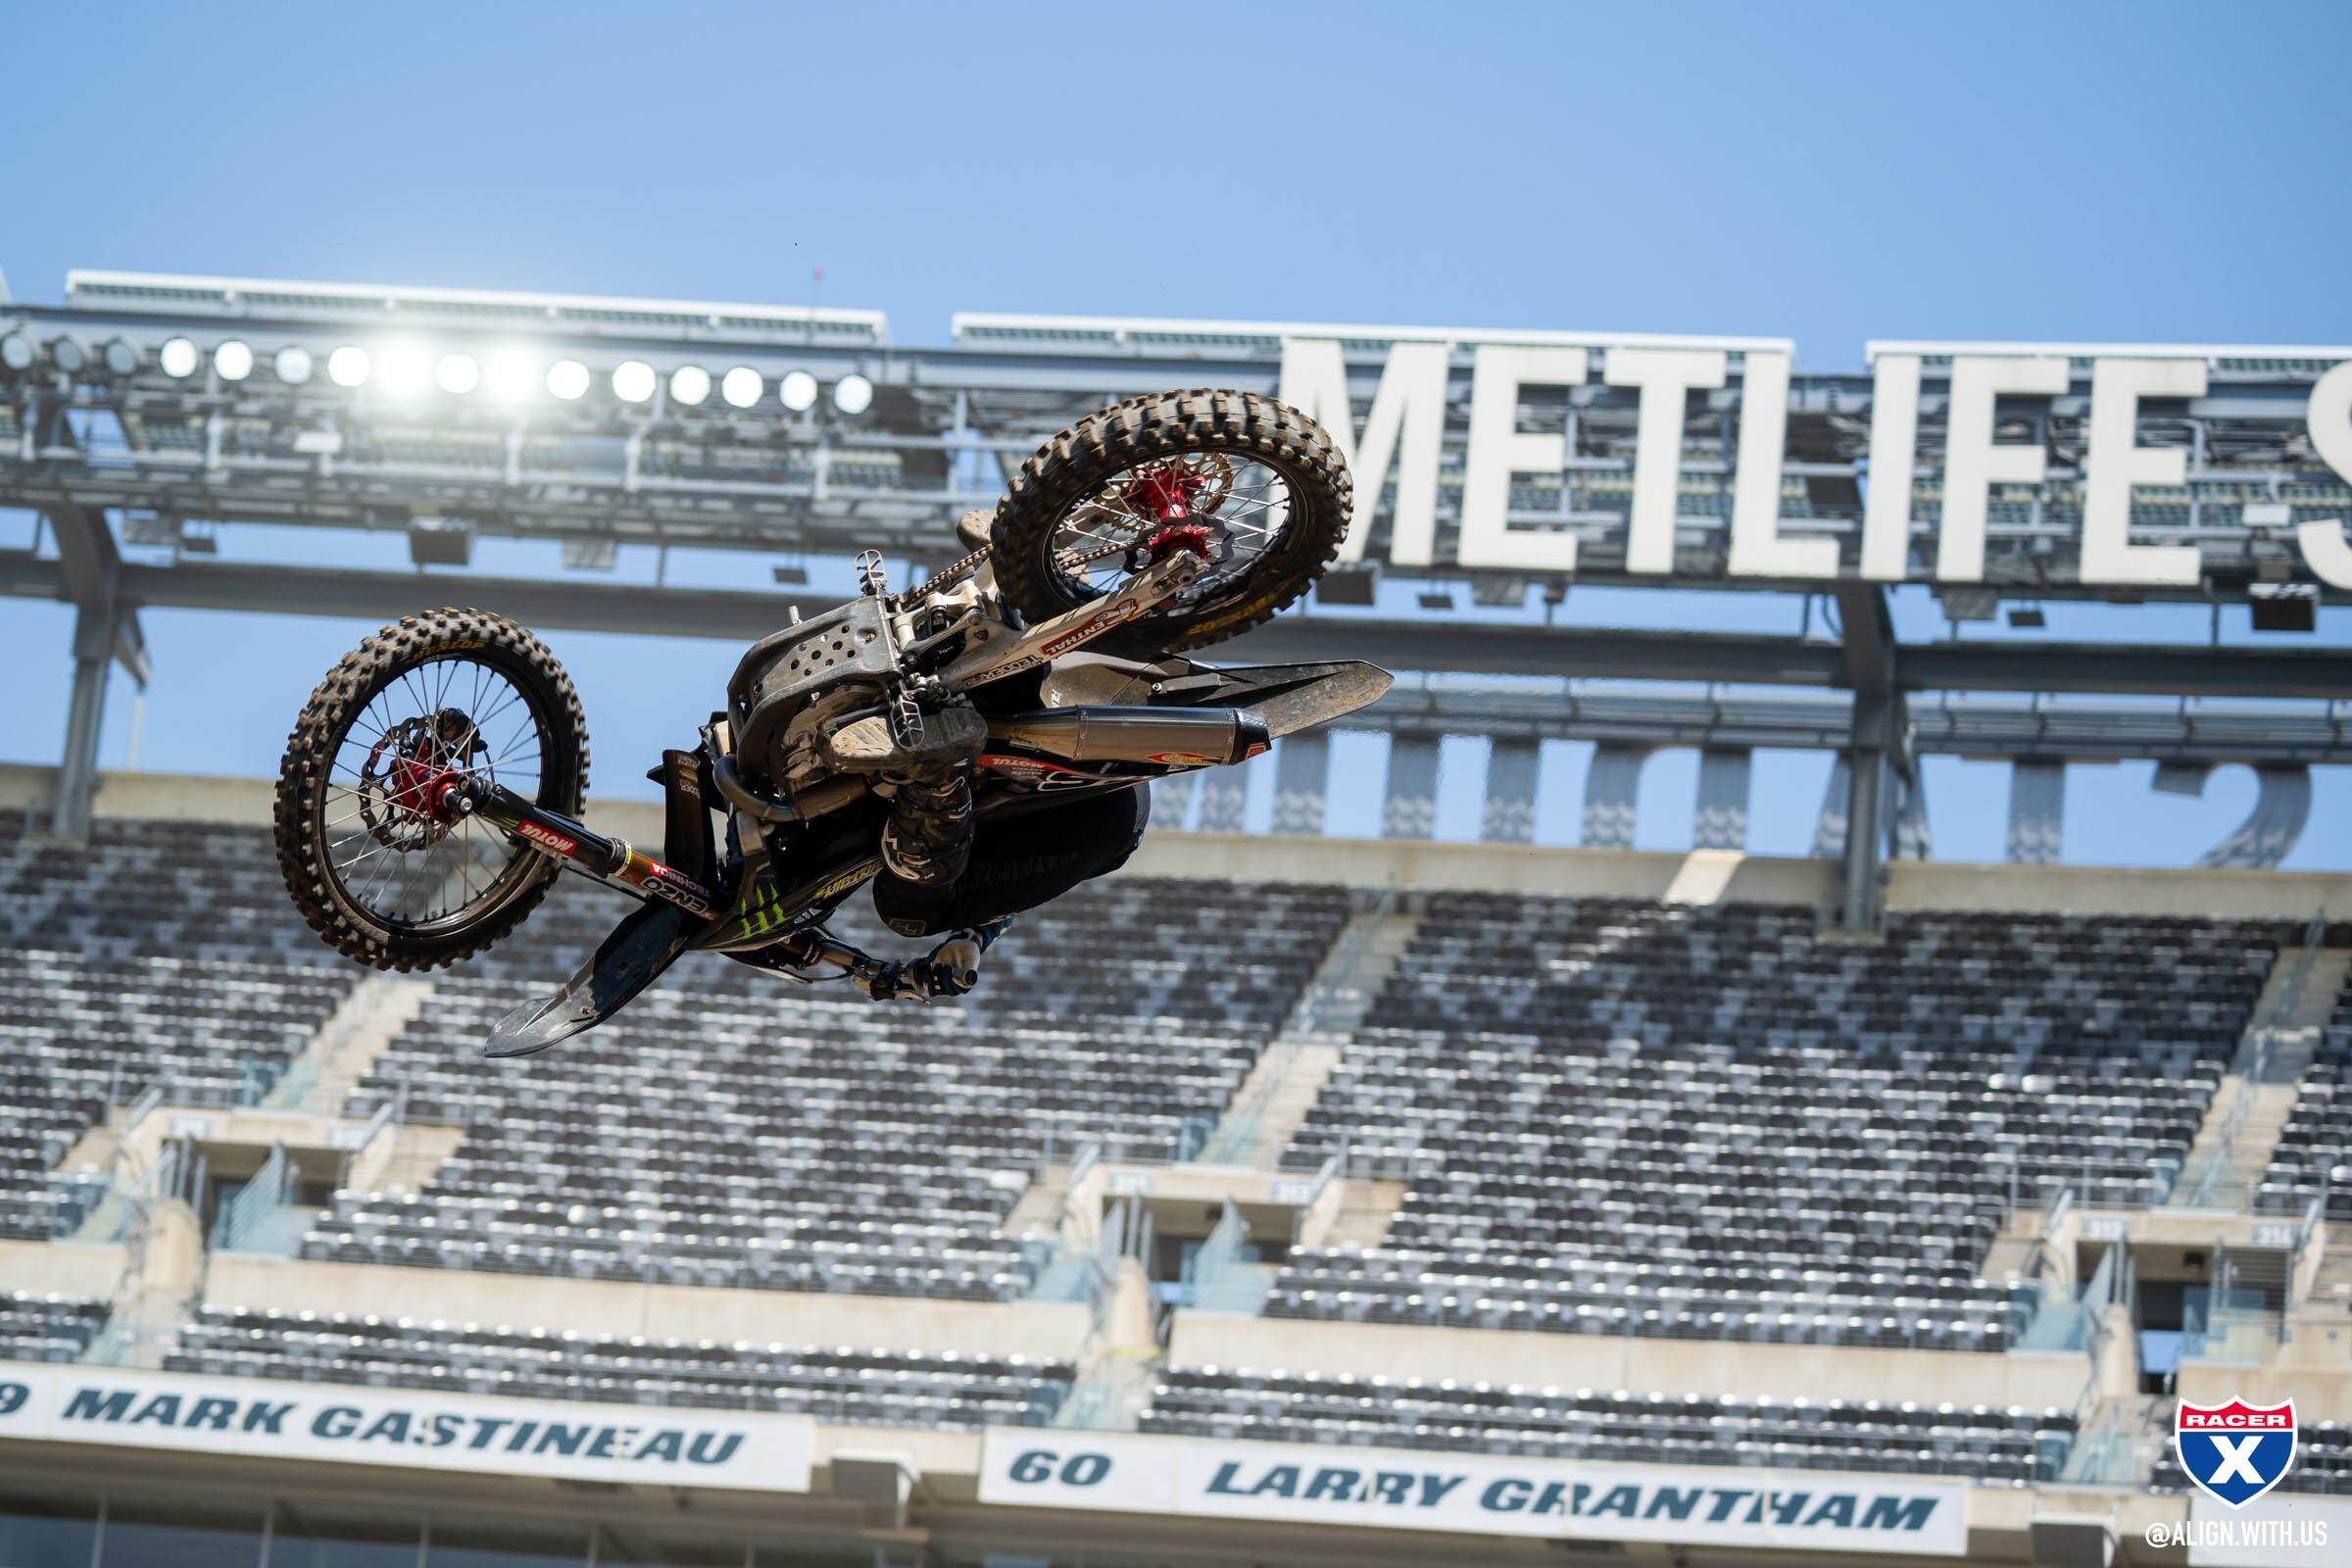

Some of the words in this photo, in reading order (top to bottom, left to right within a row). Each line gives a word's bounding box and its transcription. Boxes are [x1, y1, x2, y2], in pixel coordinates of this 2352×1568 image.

[1278, 337, 2207, 585] METLIFE
[982, 655, 1042, 680] TEDDER
[992, 758, 1045, 768] MOTUL
[518, 823, 574, 852] MOTUL
[640, 875, 709, 914] ENZO
[651, 862, 711, 898] TECHNICA
[62, 1388, 297, 1434] MARK
[310, 1405, 745, 1464] GASTINEAU
[1007, 1448, 1112, 1485] 60
[1206, 1460, 1466, 1508] LARRY
[1478, 1479, 1940, 1532] GRANTHAM
